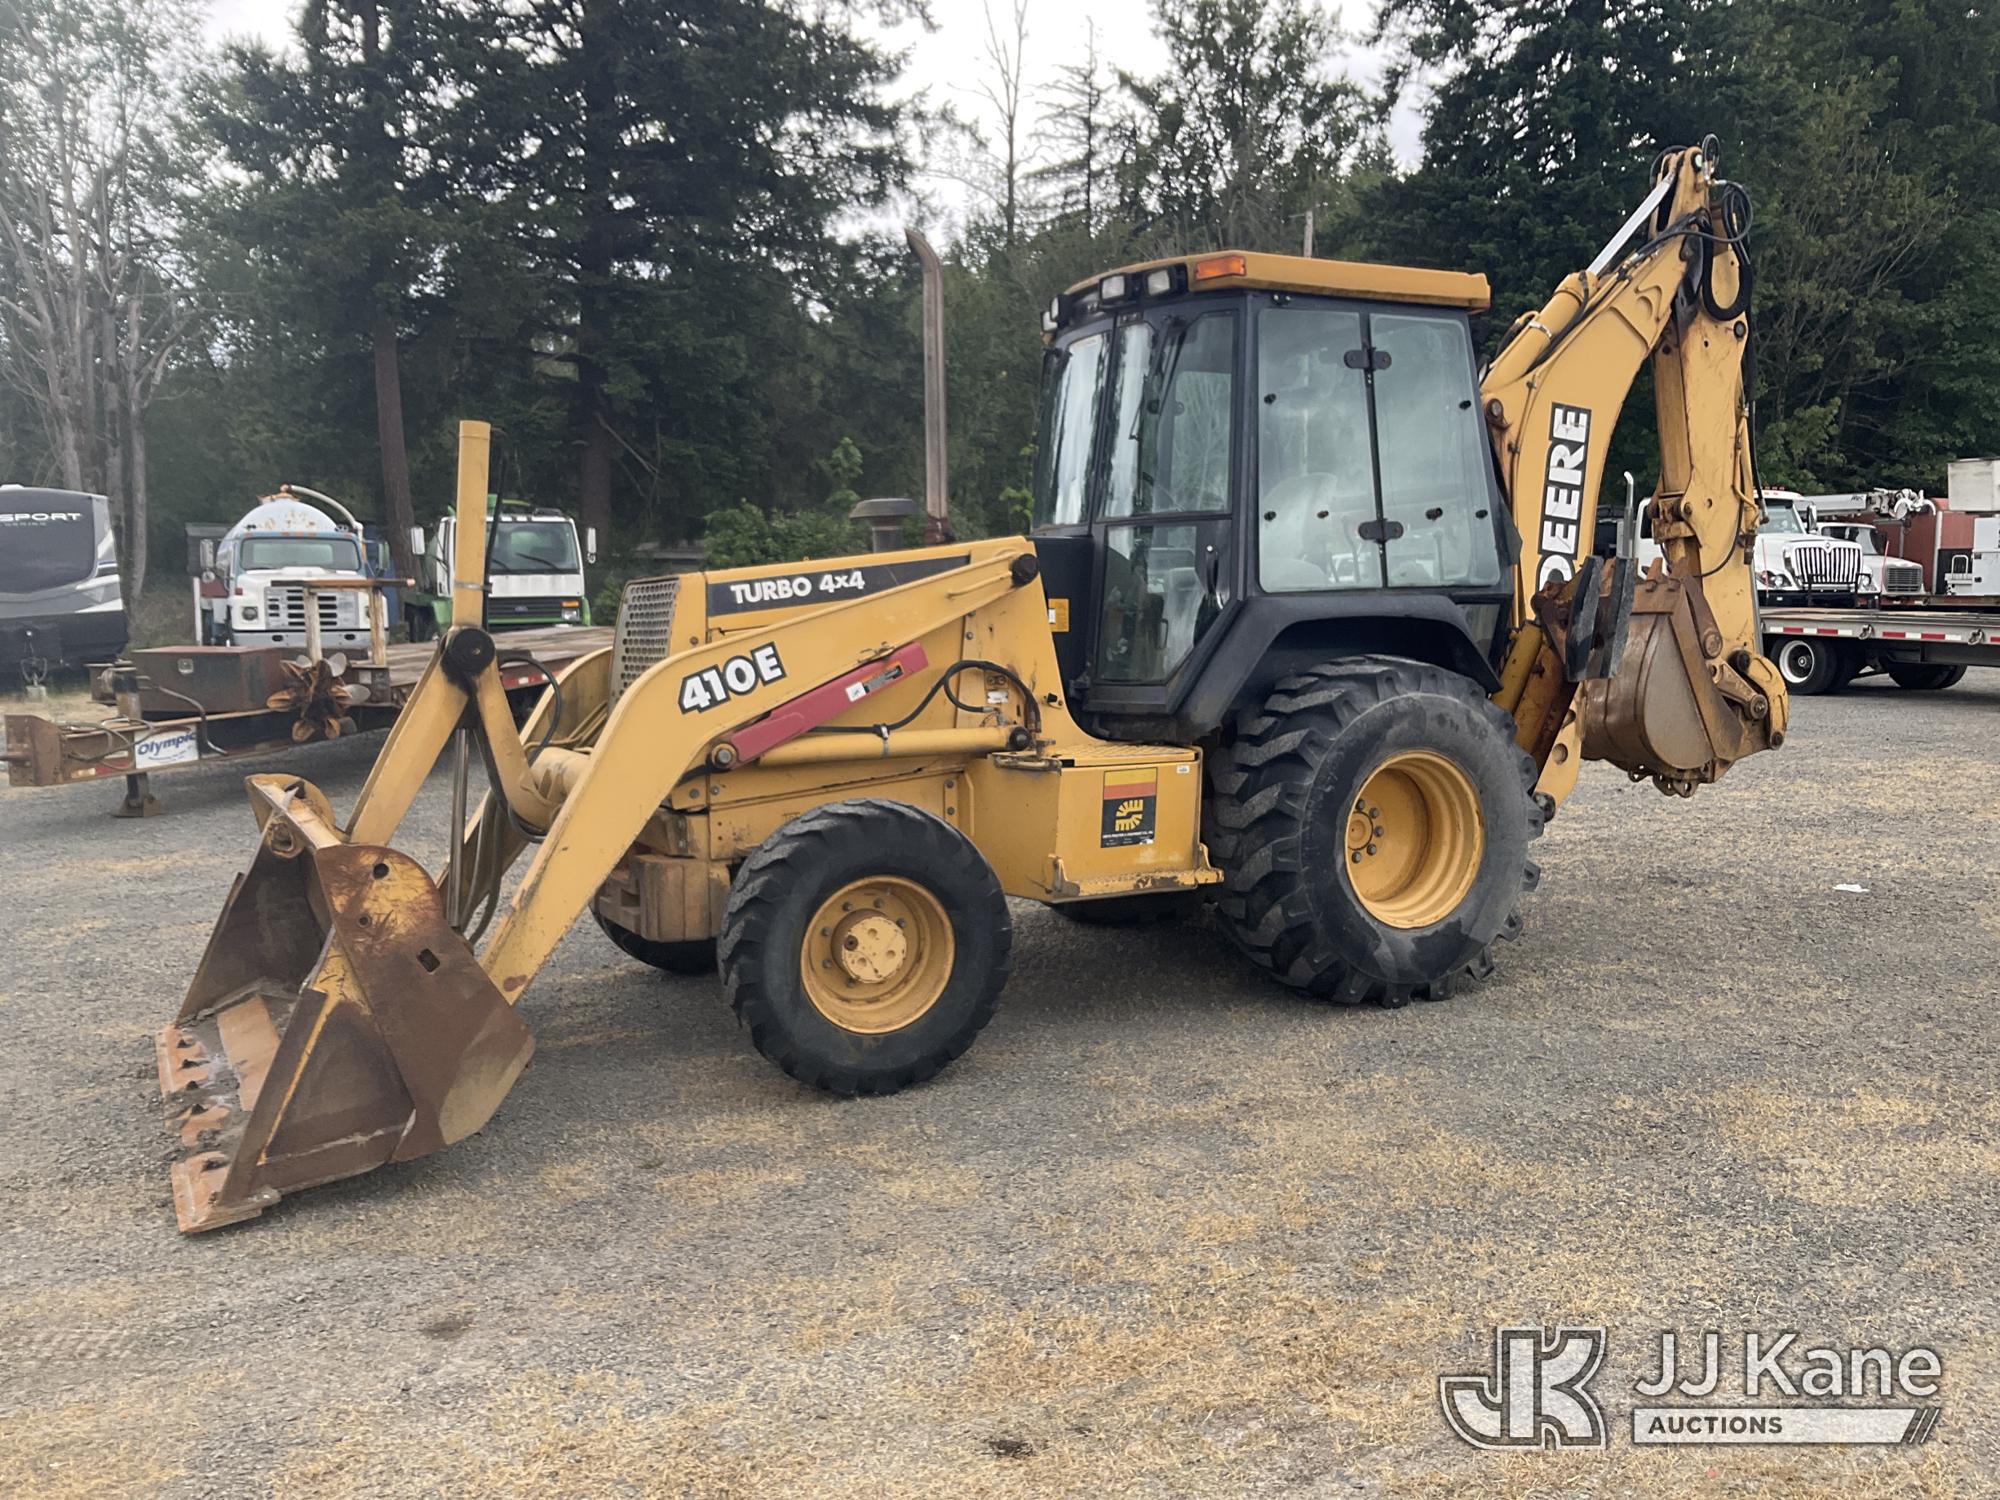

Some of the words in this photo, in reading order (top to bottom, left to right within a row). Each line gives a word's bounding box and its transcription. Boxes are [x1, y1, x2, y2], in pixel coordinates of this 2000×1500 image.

[1537, 406, 1590, 593] DEERE
[0, 512, 82, 522] SPORT
[730, 577, 812, 604] TURBO
[819, 570, 865, 593] 4x4
[681, 644, 784, 711] 410E
[137, 731, 197, 756] Olympic
